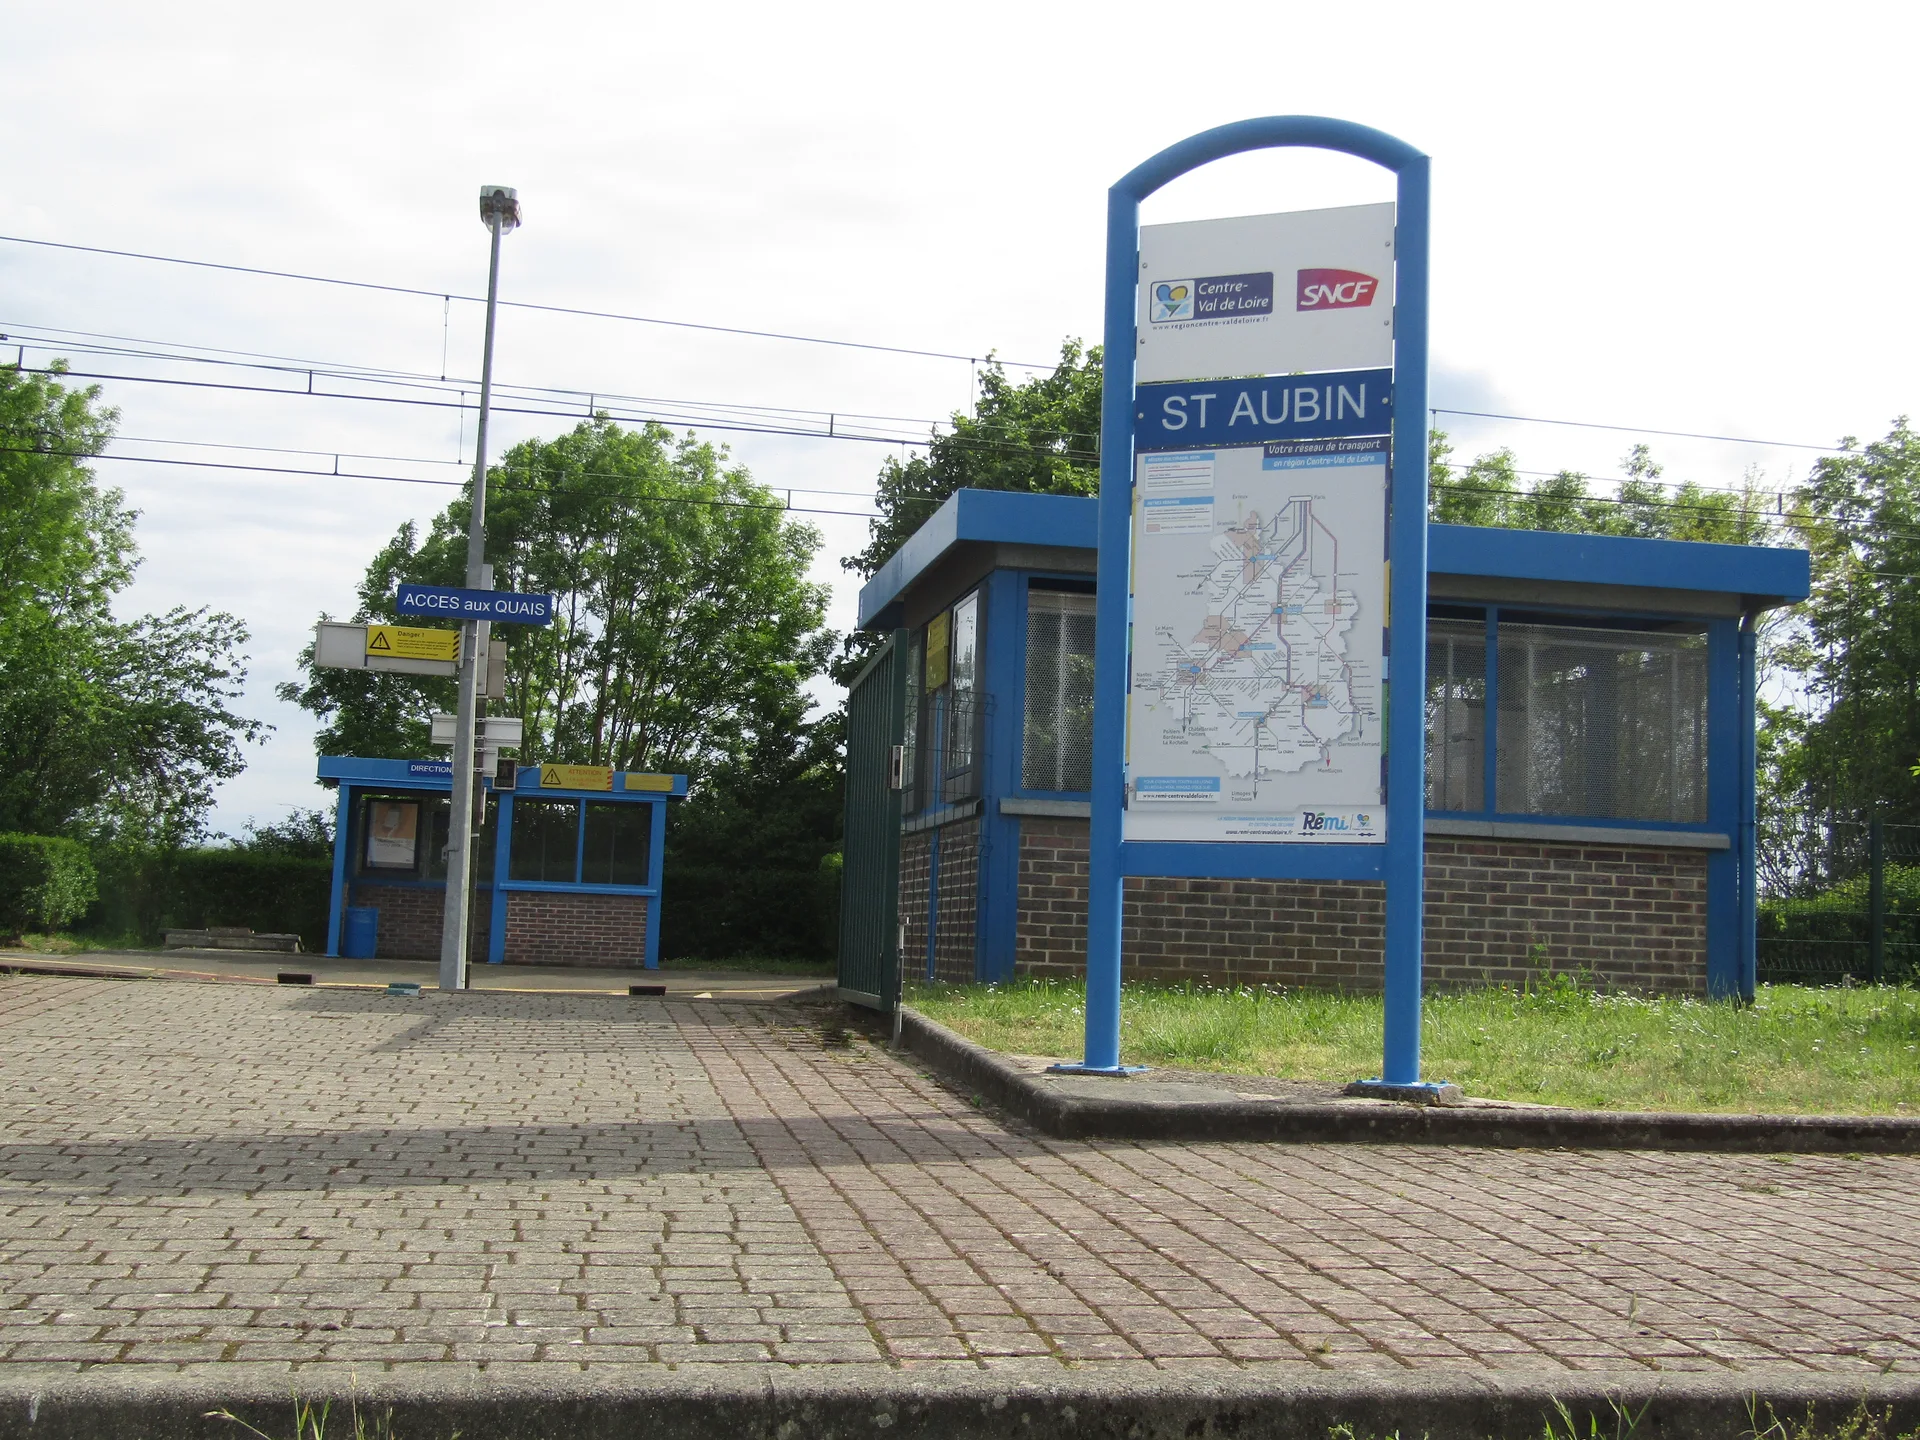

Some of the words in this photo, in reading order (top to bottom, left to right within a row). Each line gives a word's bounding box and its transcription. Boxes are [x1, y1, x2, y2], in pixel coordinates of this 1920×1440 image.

[1198, 282, 1248, 295] Centre-
[1300, 280, 1373, 307] SNCF
[1198, 298, 1218, 312] Val
[1219, 299, 1235, 311] de
[1237, 296, 1269, 309] Loire
[1161, 394, 1217, 431] ST
[1227, 383, 1366, 427] AUBIN
[1268, 445, 1293, 454] Votre
[1294, 442, 1324, 453] réseau
[1325, 442, 1337, 451] de
[1338, 440, 1381, 451] transport
[1283, 458, 1305, 468] région
[1346, 455, 1356, 463] de
[1356, 454, 1375, 463] Loire
[403, 593, 460, 609] ACCES
[464, 600, 490, 611] aux
[495, 600, 545, 616] QUAIS
[411, 764, 452, 773] DIRECTION
[1302, 811, 1349, 831] Rémi
